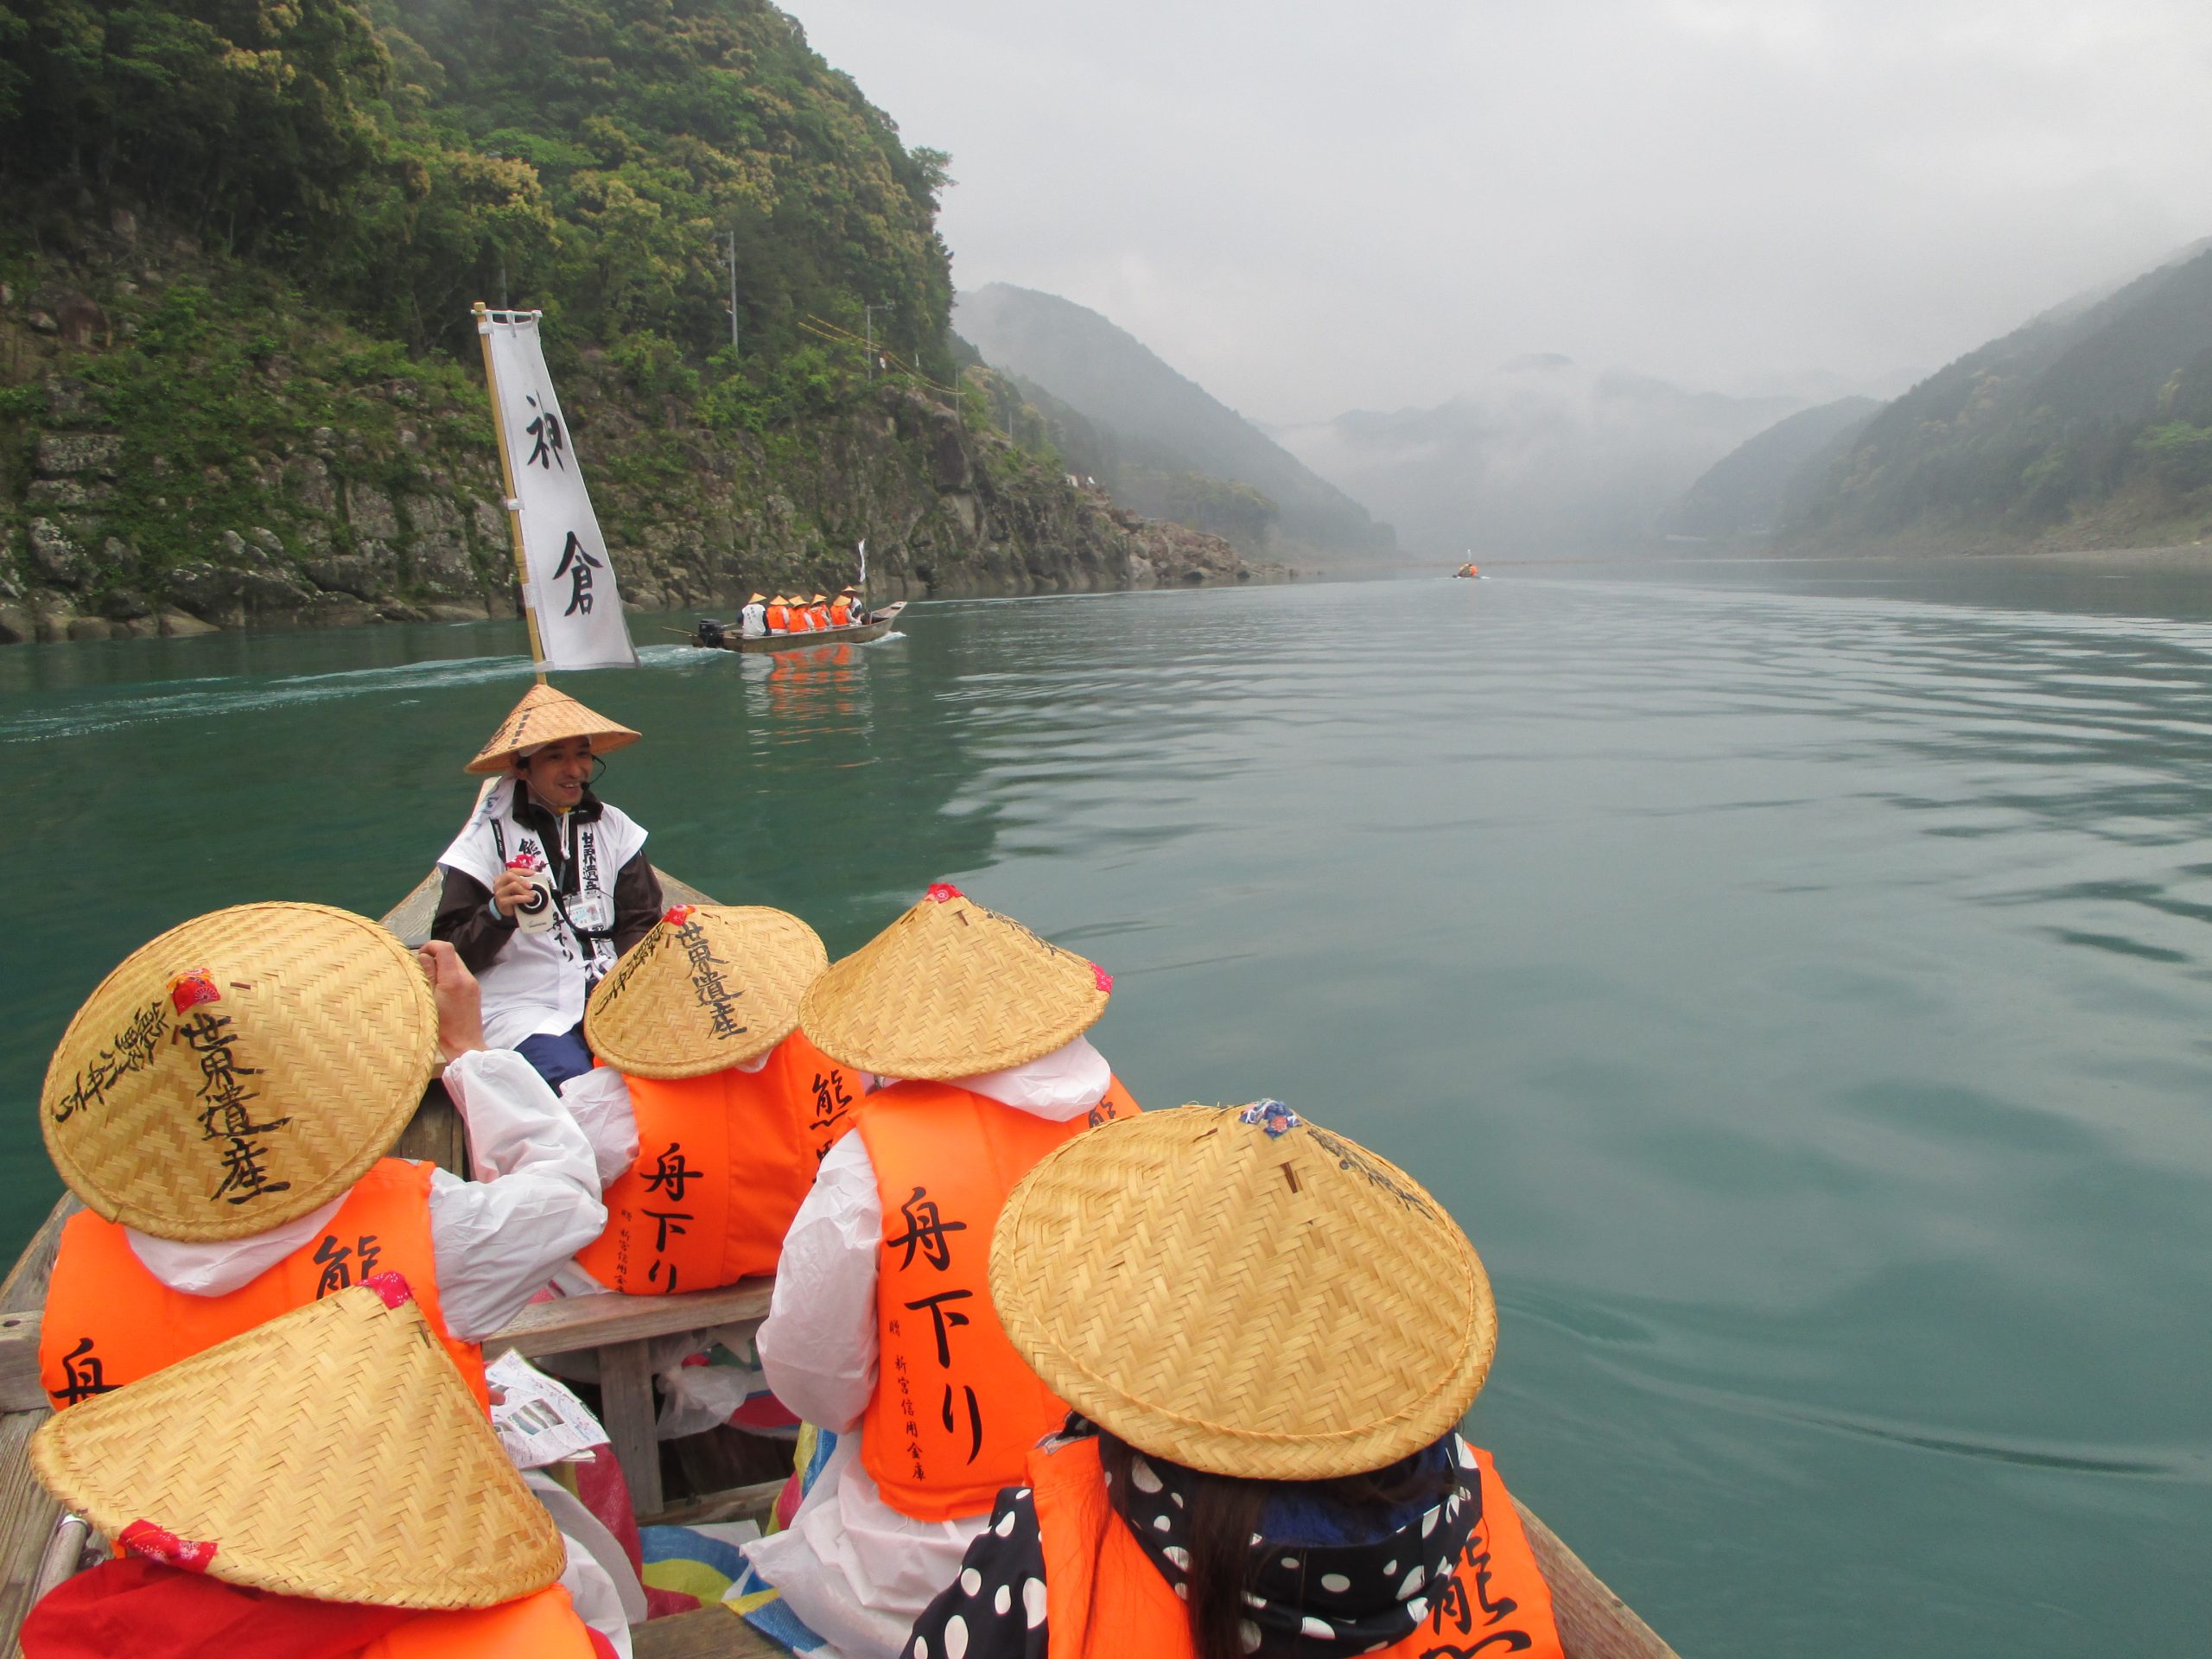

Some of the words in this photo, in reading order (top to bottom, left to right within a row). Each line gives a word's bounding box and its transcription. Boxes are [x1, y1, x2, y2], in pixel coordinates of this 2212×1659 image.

[525, 389, 604, 618] 神倉
[674, 921, 748, 1040] 世界遺産
[180, 1012, 292, 1205] 世界遺産
[639, 1141, 705, 1294] 舟下り
[887, 1186, 982, 1466] 舟下り
[894, 1354, 926, 1482] 新宮信用金庫
